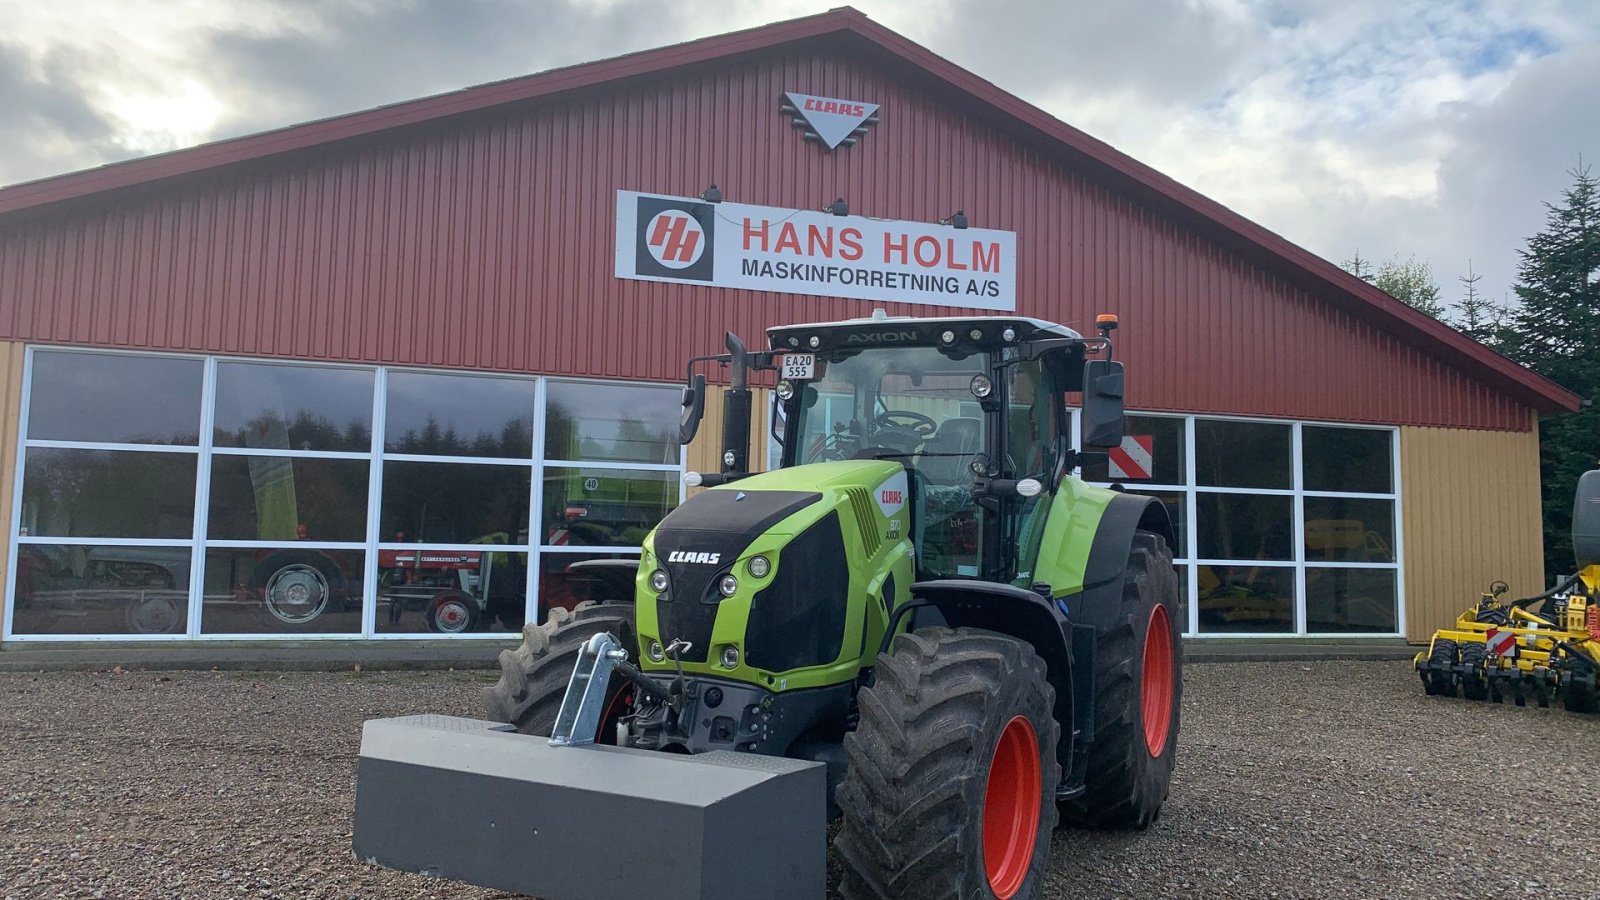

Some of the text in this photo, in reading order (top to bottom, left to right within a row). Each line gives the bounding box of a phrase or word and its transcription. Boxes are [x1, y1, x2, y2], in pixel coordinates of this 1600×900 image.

[804, 98, 864, 118] CLAAS
[742, 217, 1000, 273] HANS HOLM
[741, 258, 1000, 297] MASKINFORRETNING A/S
[847, 331, 917, 343] AXION
[786, 355, 812, 367] EA20
[788, 366, 807, 377] 555
[586, 479, 597, 489] 40
[881, 490, 902, 505] CLAAS
[668, 551, 721, 565] CLAAS
